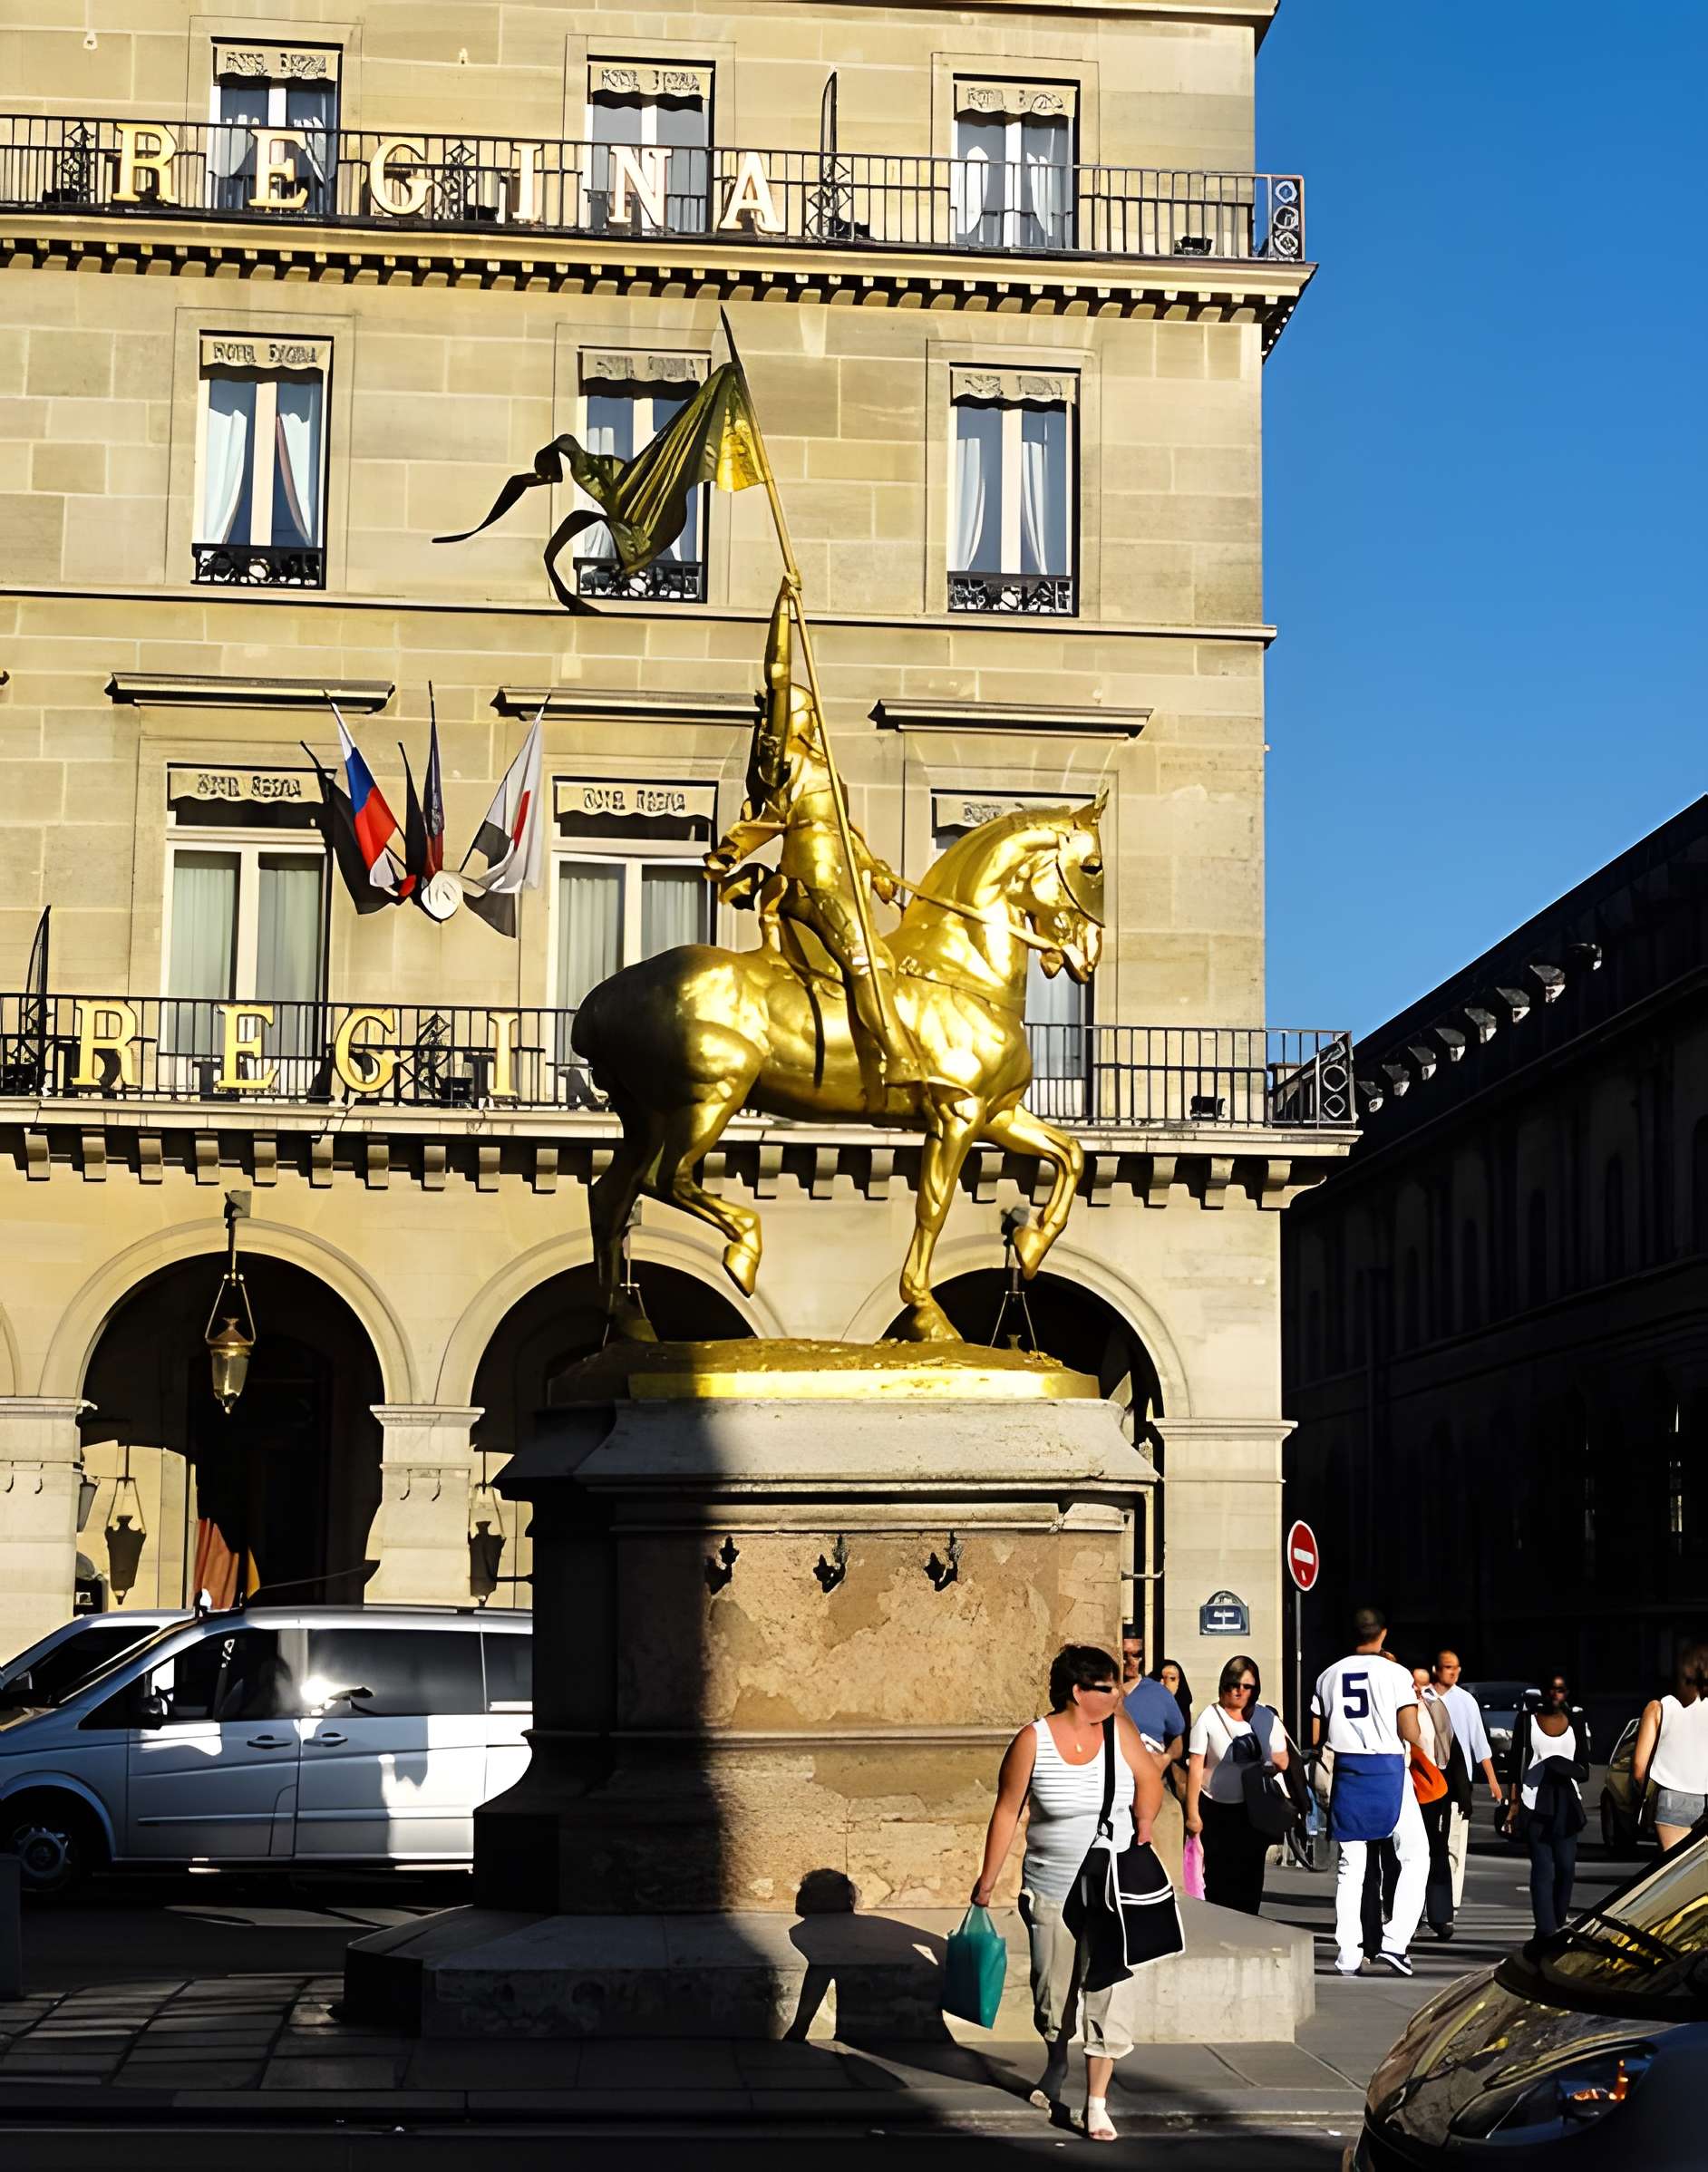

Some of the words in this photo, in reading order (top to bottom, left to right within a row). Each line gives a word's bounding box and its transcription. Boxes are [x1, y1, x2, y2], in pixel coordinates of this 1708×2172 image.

[112, 122, 787, 233] REGINA
[73, 999, 519, 1097] REGI
[1342, 1672, 1369, 1719] 5
